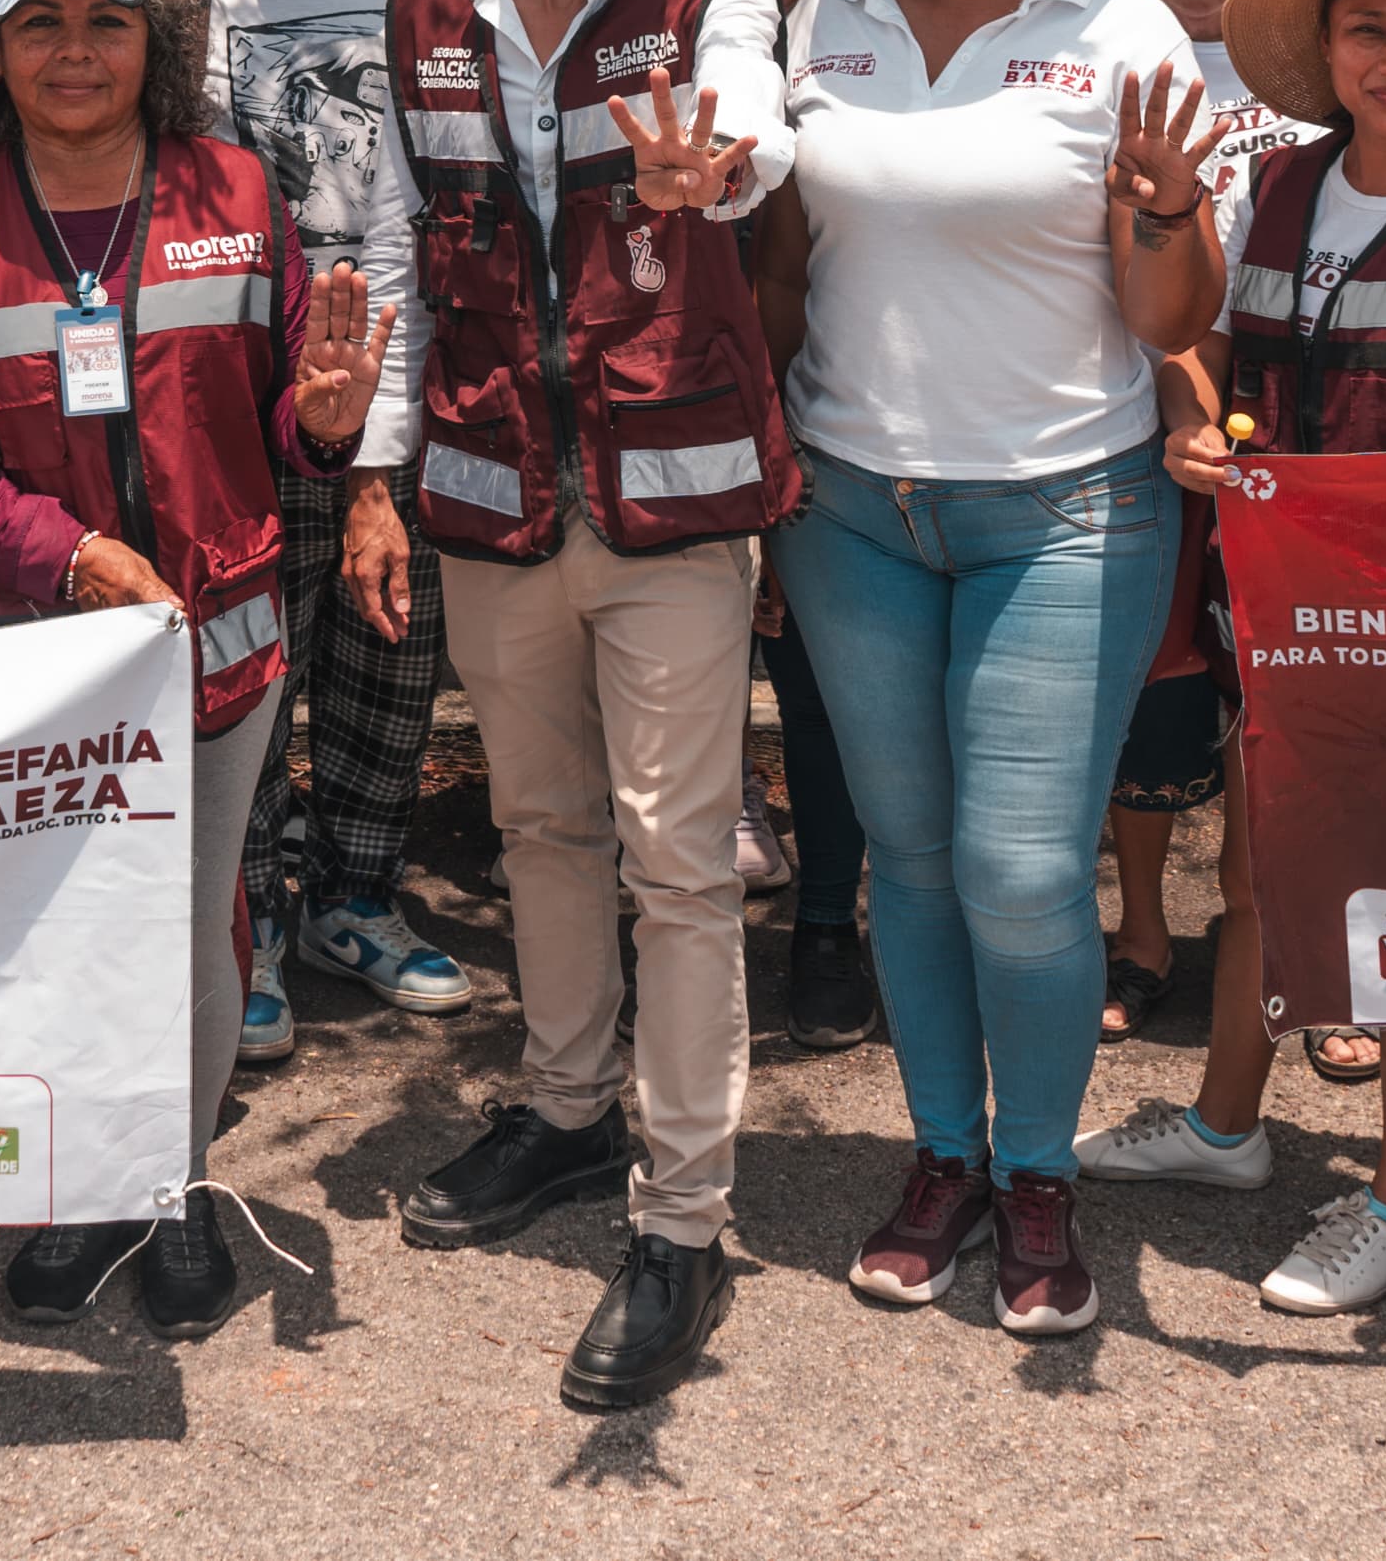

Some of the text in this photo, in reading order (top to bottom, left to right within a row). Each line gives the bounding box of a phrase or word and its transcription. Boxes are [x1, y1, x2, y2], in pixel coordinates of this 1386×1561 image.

[431, 47, 472, 59] SEGURO
[595, 28, 677, 63] CLAUDIA
[597, 41, 679, 76] SHEINBAUM
[1008, 59, 1095, 79] ESTEFANÍA
[1004, 71, 1092, 93] BAEZA
[167, 254, 241, 271] La esperanza de
[1315, 251, 1337, 265] DE
[69, 327, 115, 339] UNIDAD
[1252, 645, 1325, 668] PARA
[26, 817, 60, 834] LOC.
[63, 812, 106, 827] DTTO
[110, 812, 121, 825] 4
